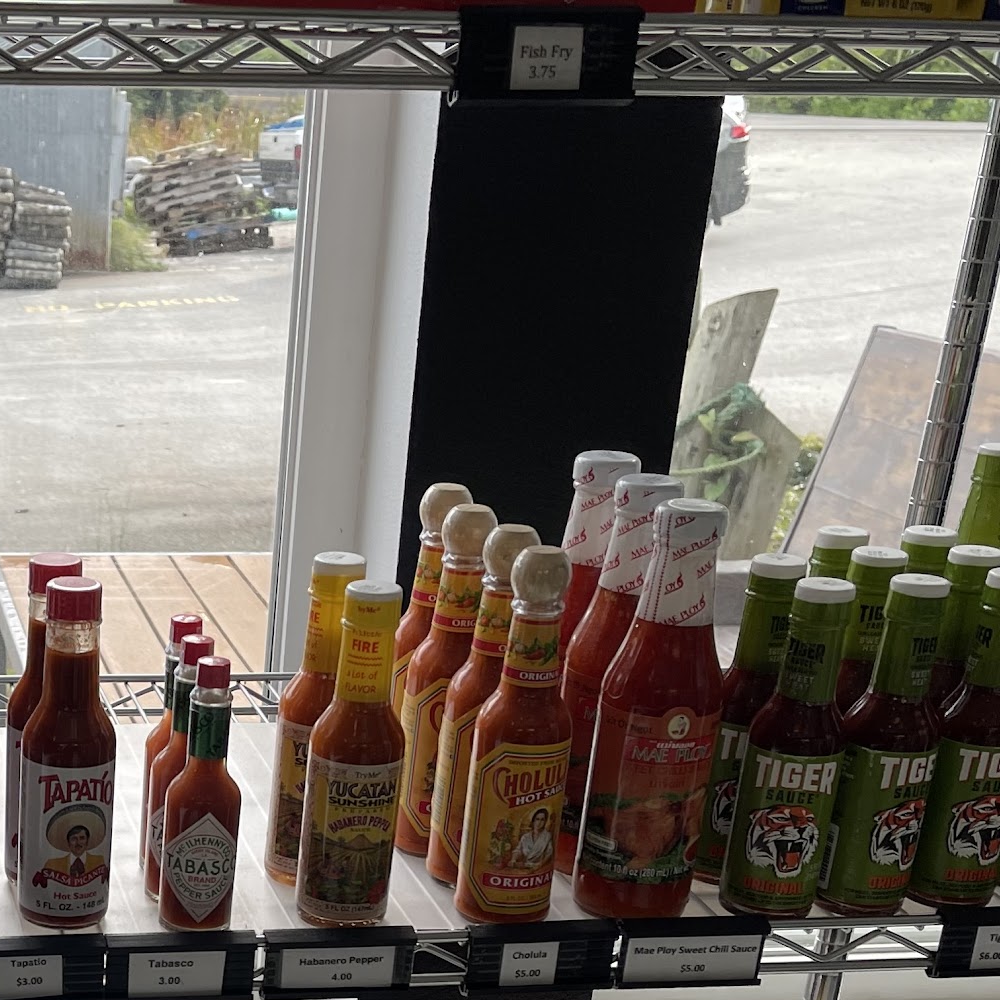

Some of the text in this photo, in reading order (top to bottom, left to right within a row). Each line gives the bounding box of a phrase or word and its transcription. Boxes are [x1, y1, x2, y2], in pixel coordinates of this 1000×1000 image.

[520, 44, 574, 61] Fish Fry
[528, 65, 557, 79] 3.75
[860, 604, 884, 623] TIG
[352, 639, 379, 653] FIRE
[368, 670, 378, 680] of
[519, 671, 559, 681] ORIGIN
[345, 682, 377, 693] FLAVOR
[632, 745, 669, 763] MAE
[880, 753, 938, 790] TIGE
[959, 748, 1000, 782] TIG
[755, 754, 838, 795] TIGER
[327, 779, 398, 798] YUCATAN
[493, 765, 567, 804] CHOLUL
[515, 793, 541, 806] HOT
[766, 789, 815, 805] SAUCE
[328, 815, 367, 834] HABANERO
[42, 868, 71, 886] SALSA
[188, 875, 217, 884] BRAND
[490, 874, 551, 887] ORIGINA
[174, 872, 202, 900] PEPPER
[744, 876, 804, 895] ORIGINAL
[53, 890, 98, 900] Hot Sauce
[36, 900, 41, 908] 5
[82, 901, 96, 910] 148
[512, 950, 548, 960] Cholula
[634, 943, 757, 956] Mae Ploy Sweet Chili Sauce
[148, 959, 194, 968] Tabasco
[299, 955, 384, 967] Habanero Pepper
[515, 968, 541, 979] $5.00
[680, 963, 706, 974] $5.00
[16, 976, 43, 987] $3.00
[158, 976, 181, 985] 3.00
[331, 973, 352, 981] 4.00
